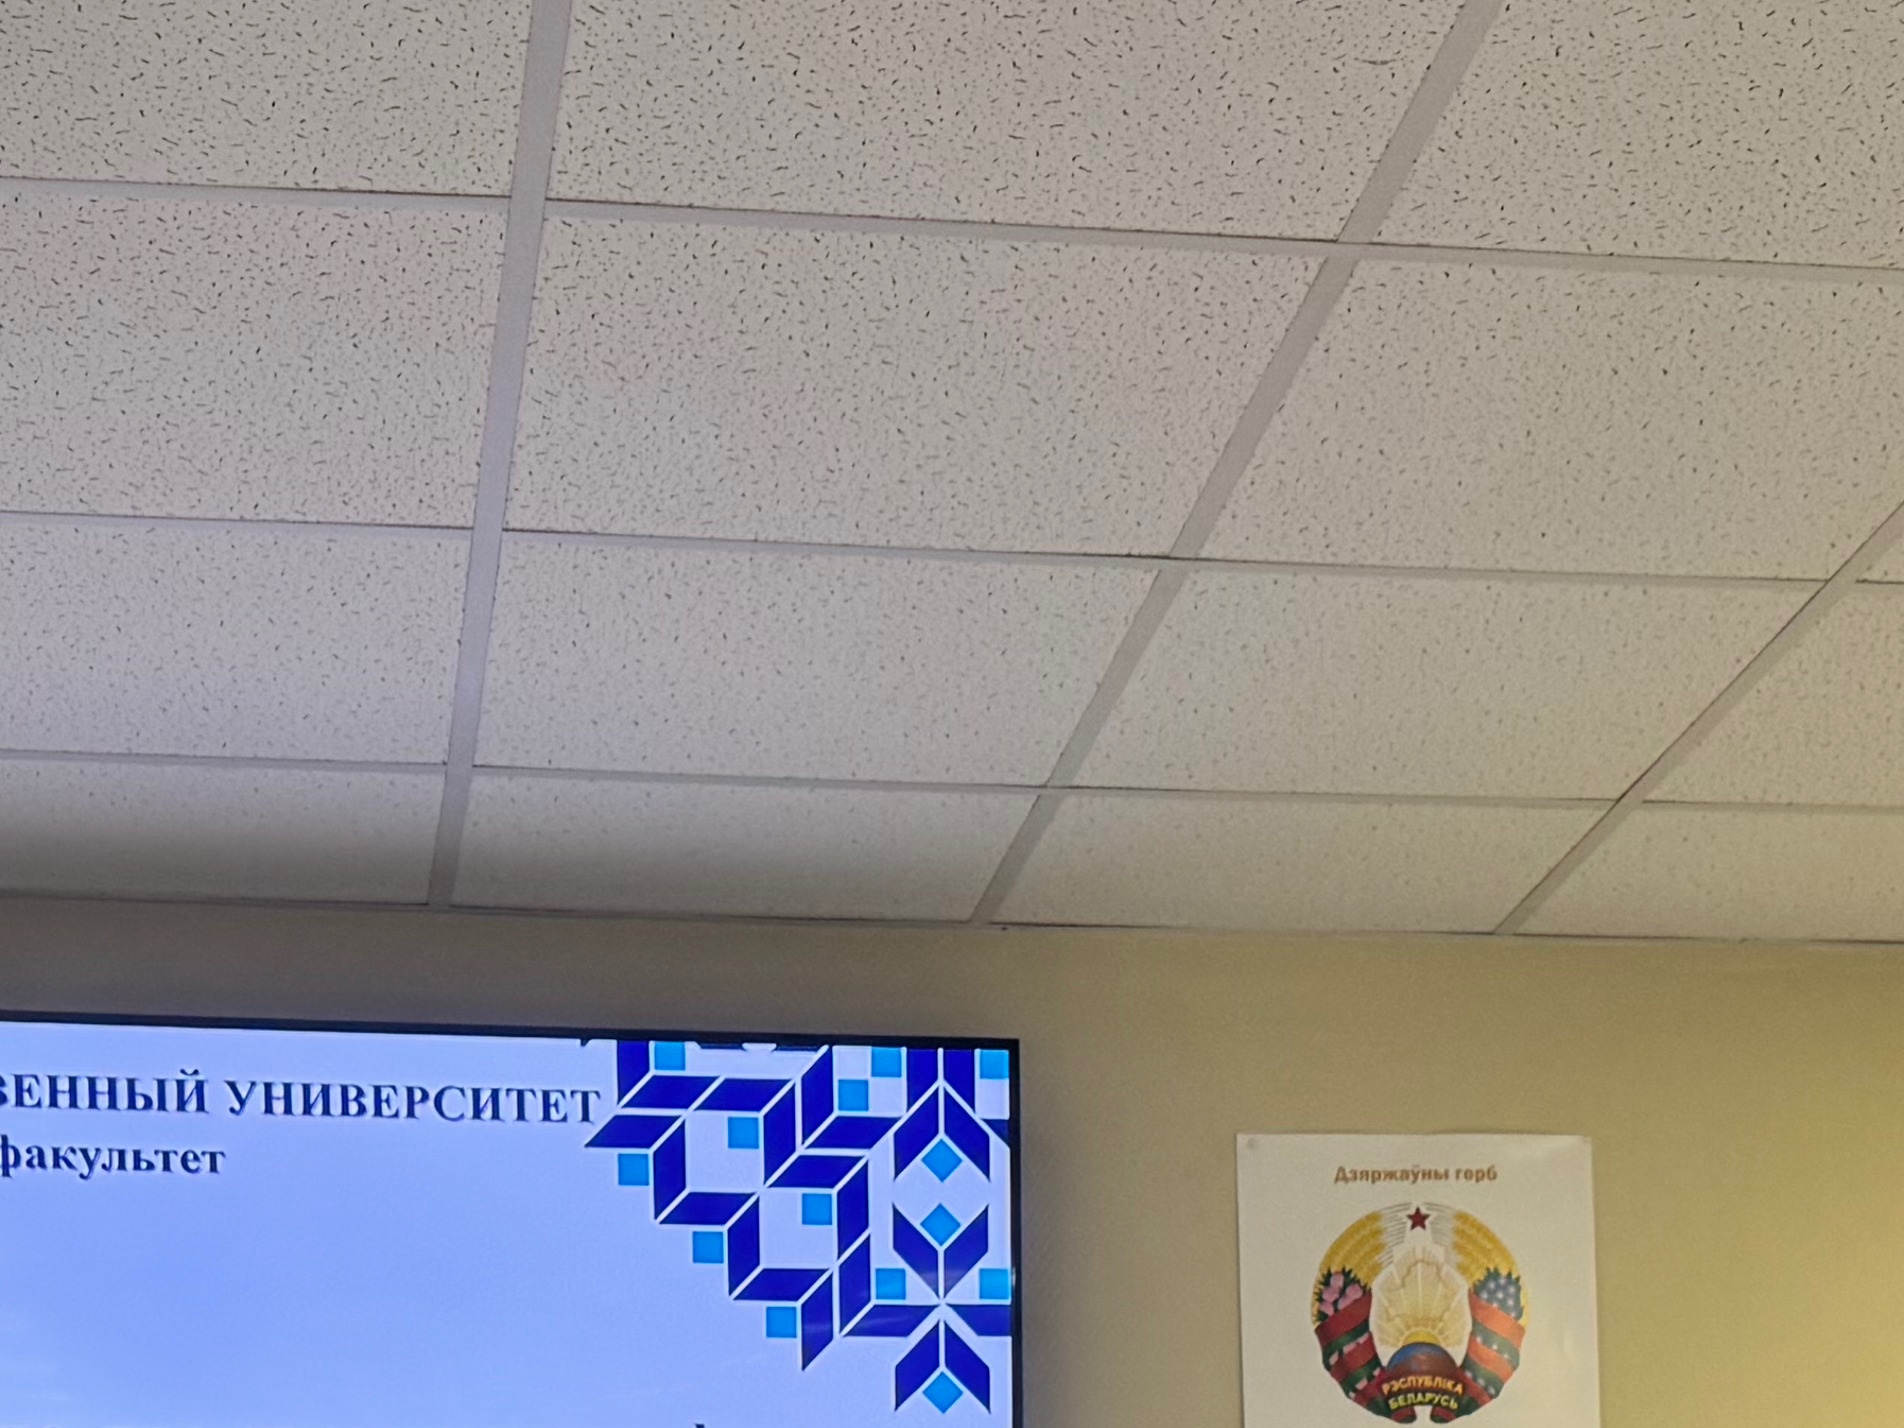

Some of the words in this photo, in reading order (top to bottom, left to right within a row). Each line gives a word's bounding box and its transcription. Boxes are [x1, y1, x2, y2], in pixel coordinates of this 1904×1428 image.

[223, 1079, 601, 1126] УНИВЕРСИТЕТ
[1334, 1164, 1449, 1184] Дзяржаўны
[1388, 1392, 1458, 1411] БЕЛАРУСЬ
